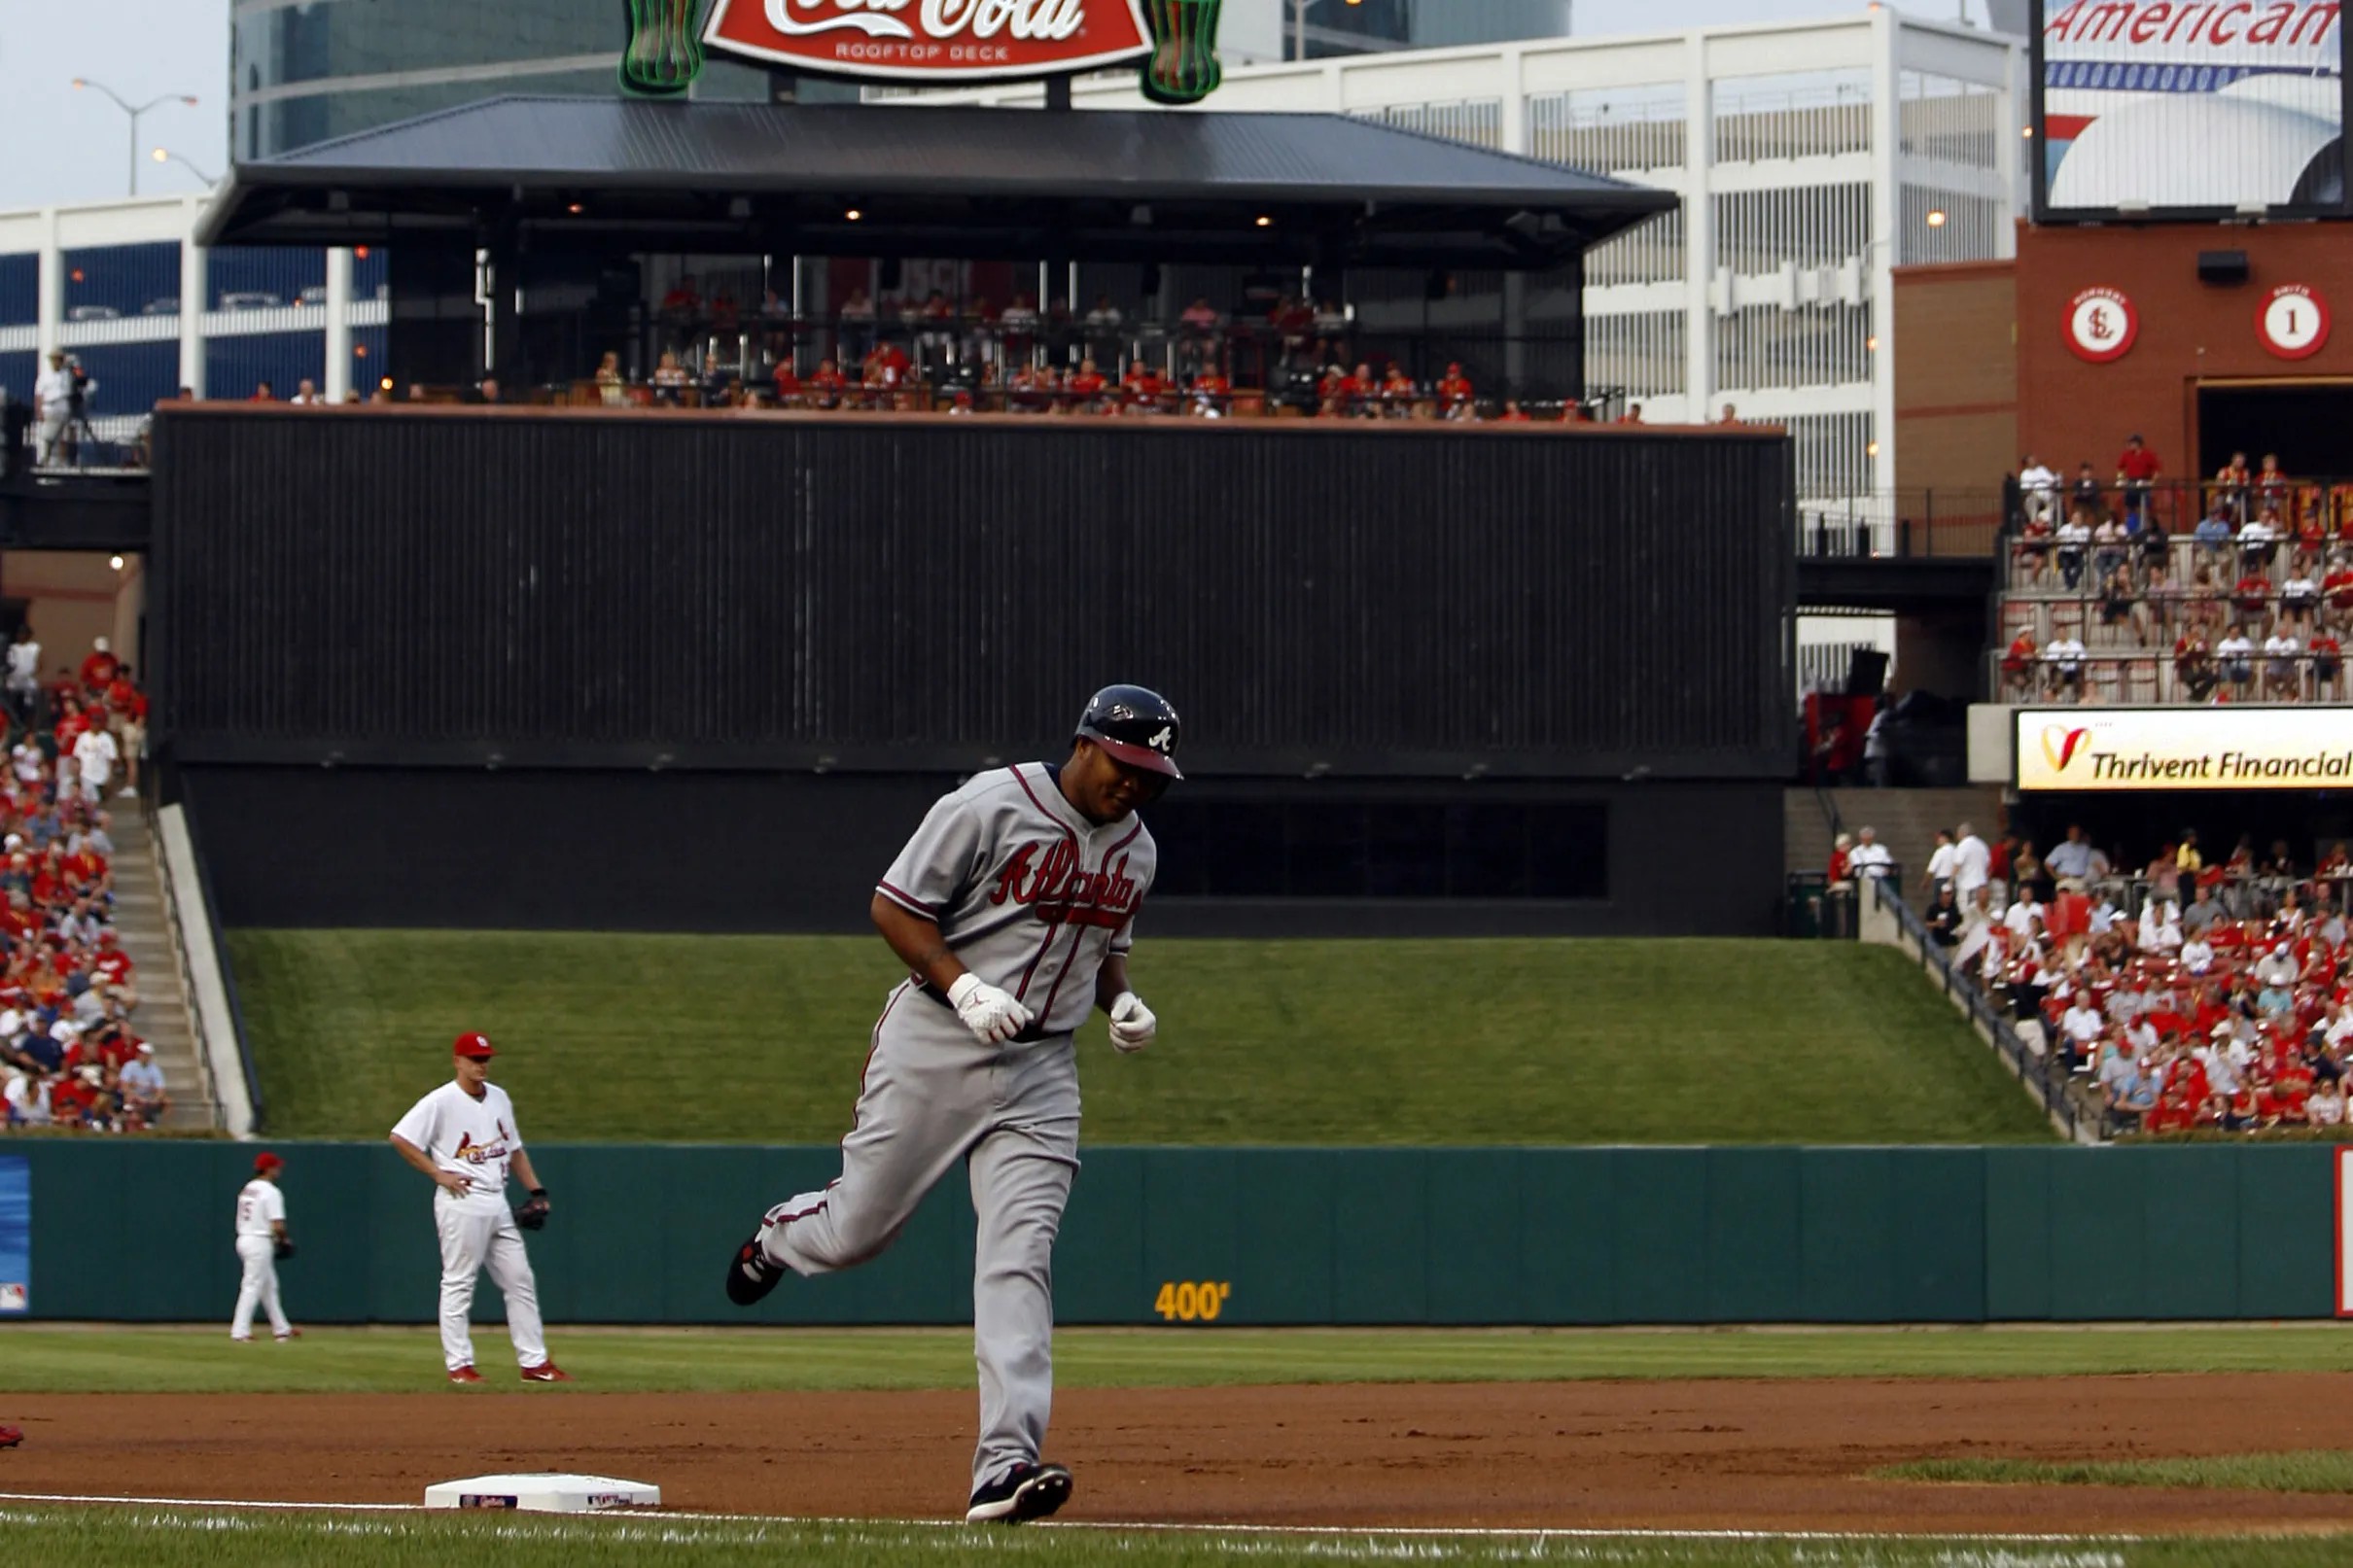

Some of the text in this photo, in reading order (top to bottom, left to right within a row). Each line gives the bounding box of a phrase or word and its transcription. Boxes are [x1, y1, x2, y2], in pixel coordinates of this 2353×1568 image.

[2044, 0, 2340, 46] American
[835, 43, 1008, 60] ROOFTOP DECK
[2286, 308, 2299, 334] 1
[2090, 750, 2351, 780] Thrivent Financial
[990, 839, 1136, 908] Atlanta
[1154, 1280, 1231, 1321] 400'
